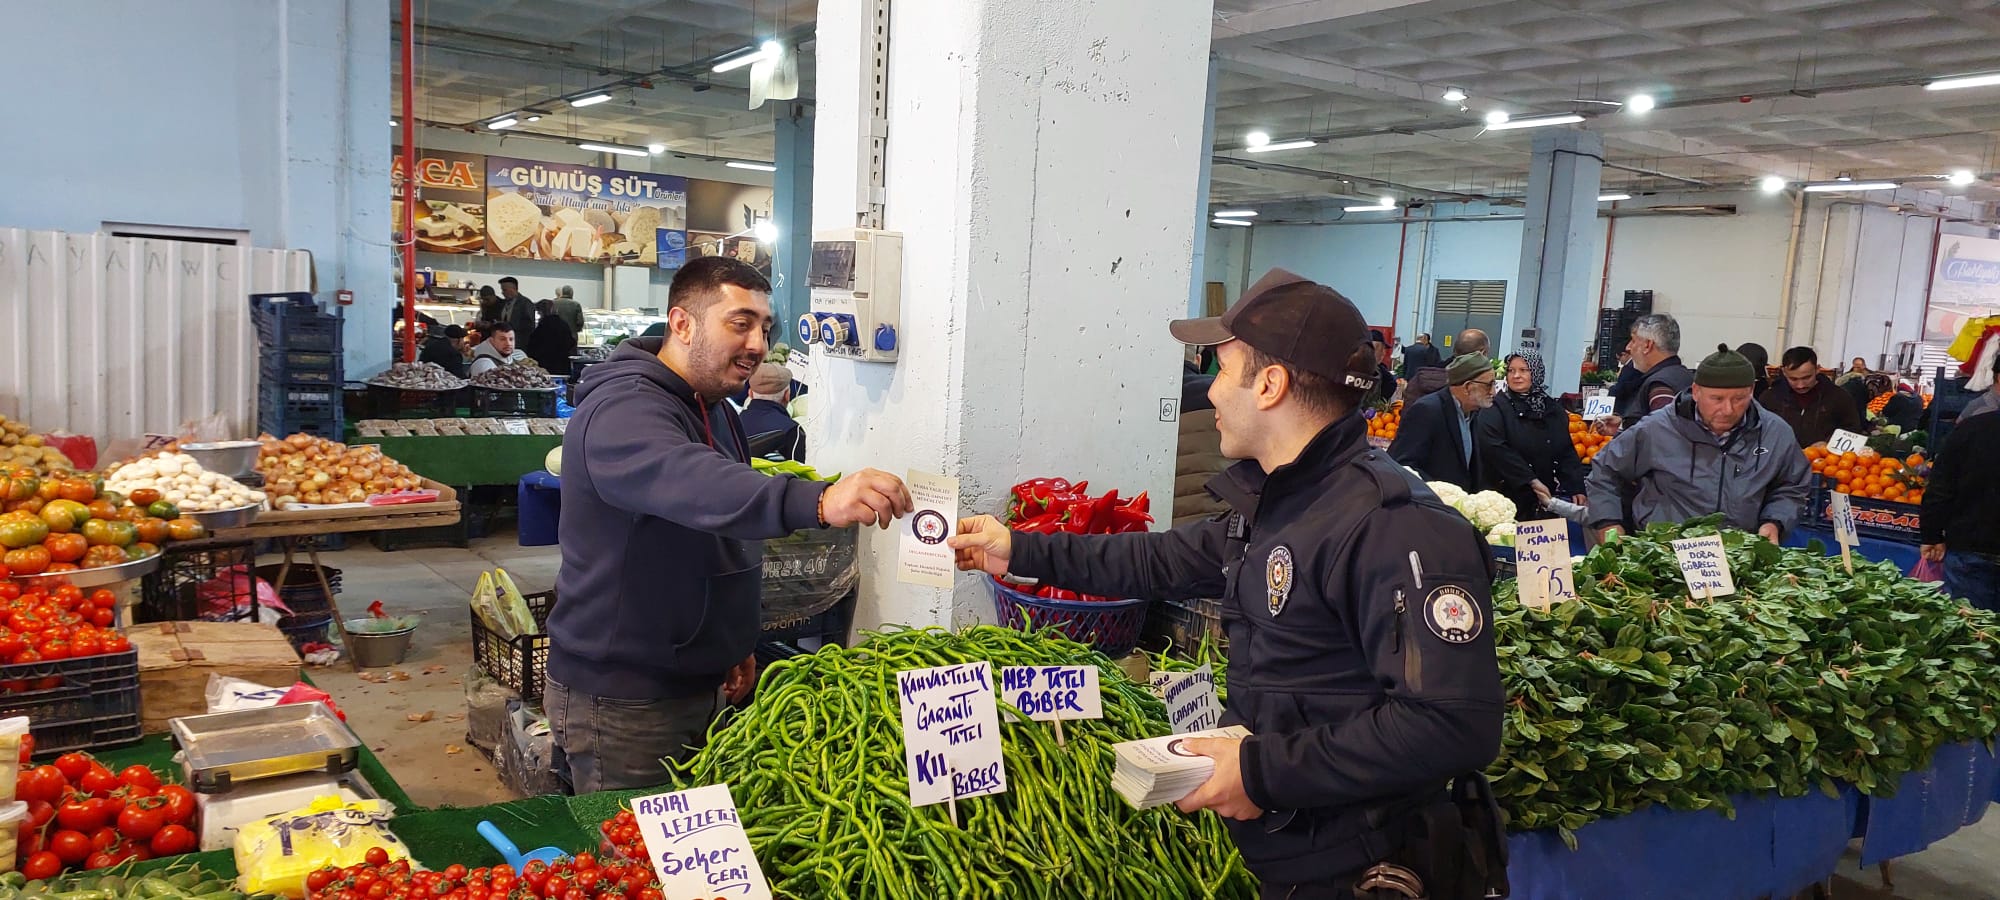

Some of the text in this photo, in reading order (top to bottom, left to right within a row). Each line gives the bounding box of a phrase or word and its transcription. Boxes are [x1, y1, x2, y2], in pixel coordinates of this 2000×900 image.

[511, 165, 602, 198] GÜMÜŞ
[610, 176, 657, 199] SÜT
[1440, 588, 1465, 598] BURSA
[901, 664, 989, 705] KAHVALTILIK
[1003, 667, 1085, 691] HEP TATLI
[1186, 709, 1216, 733] TATLI
[940, 723, 983, 746] TATLI
[639, 793, 690, 815] AŞIRI
